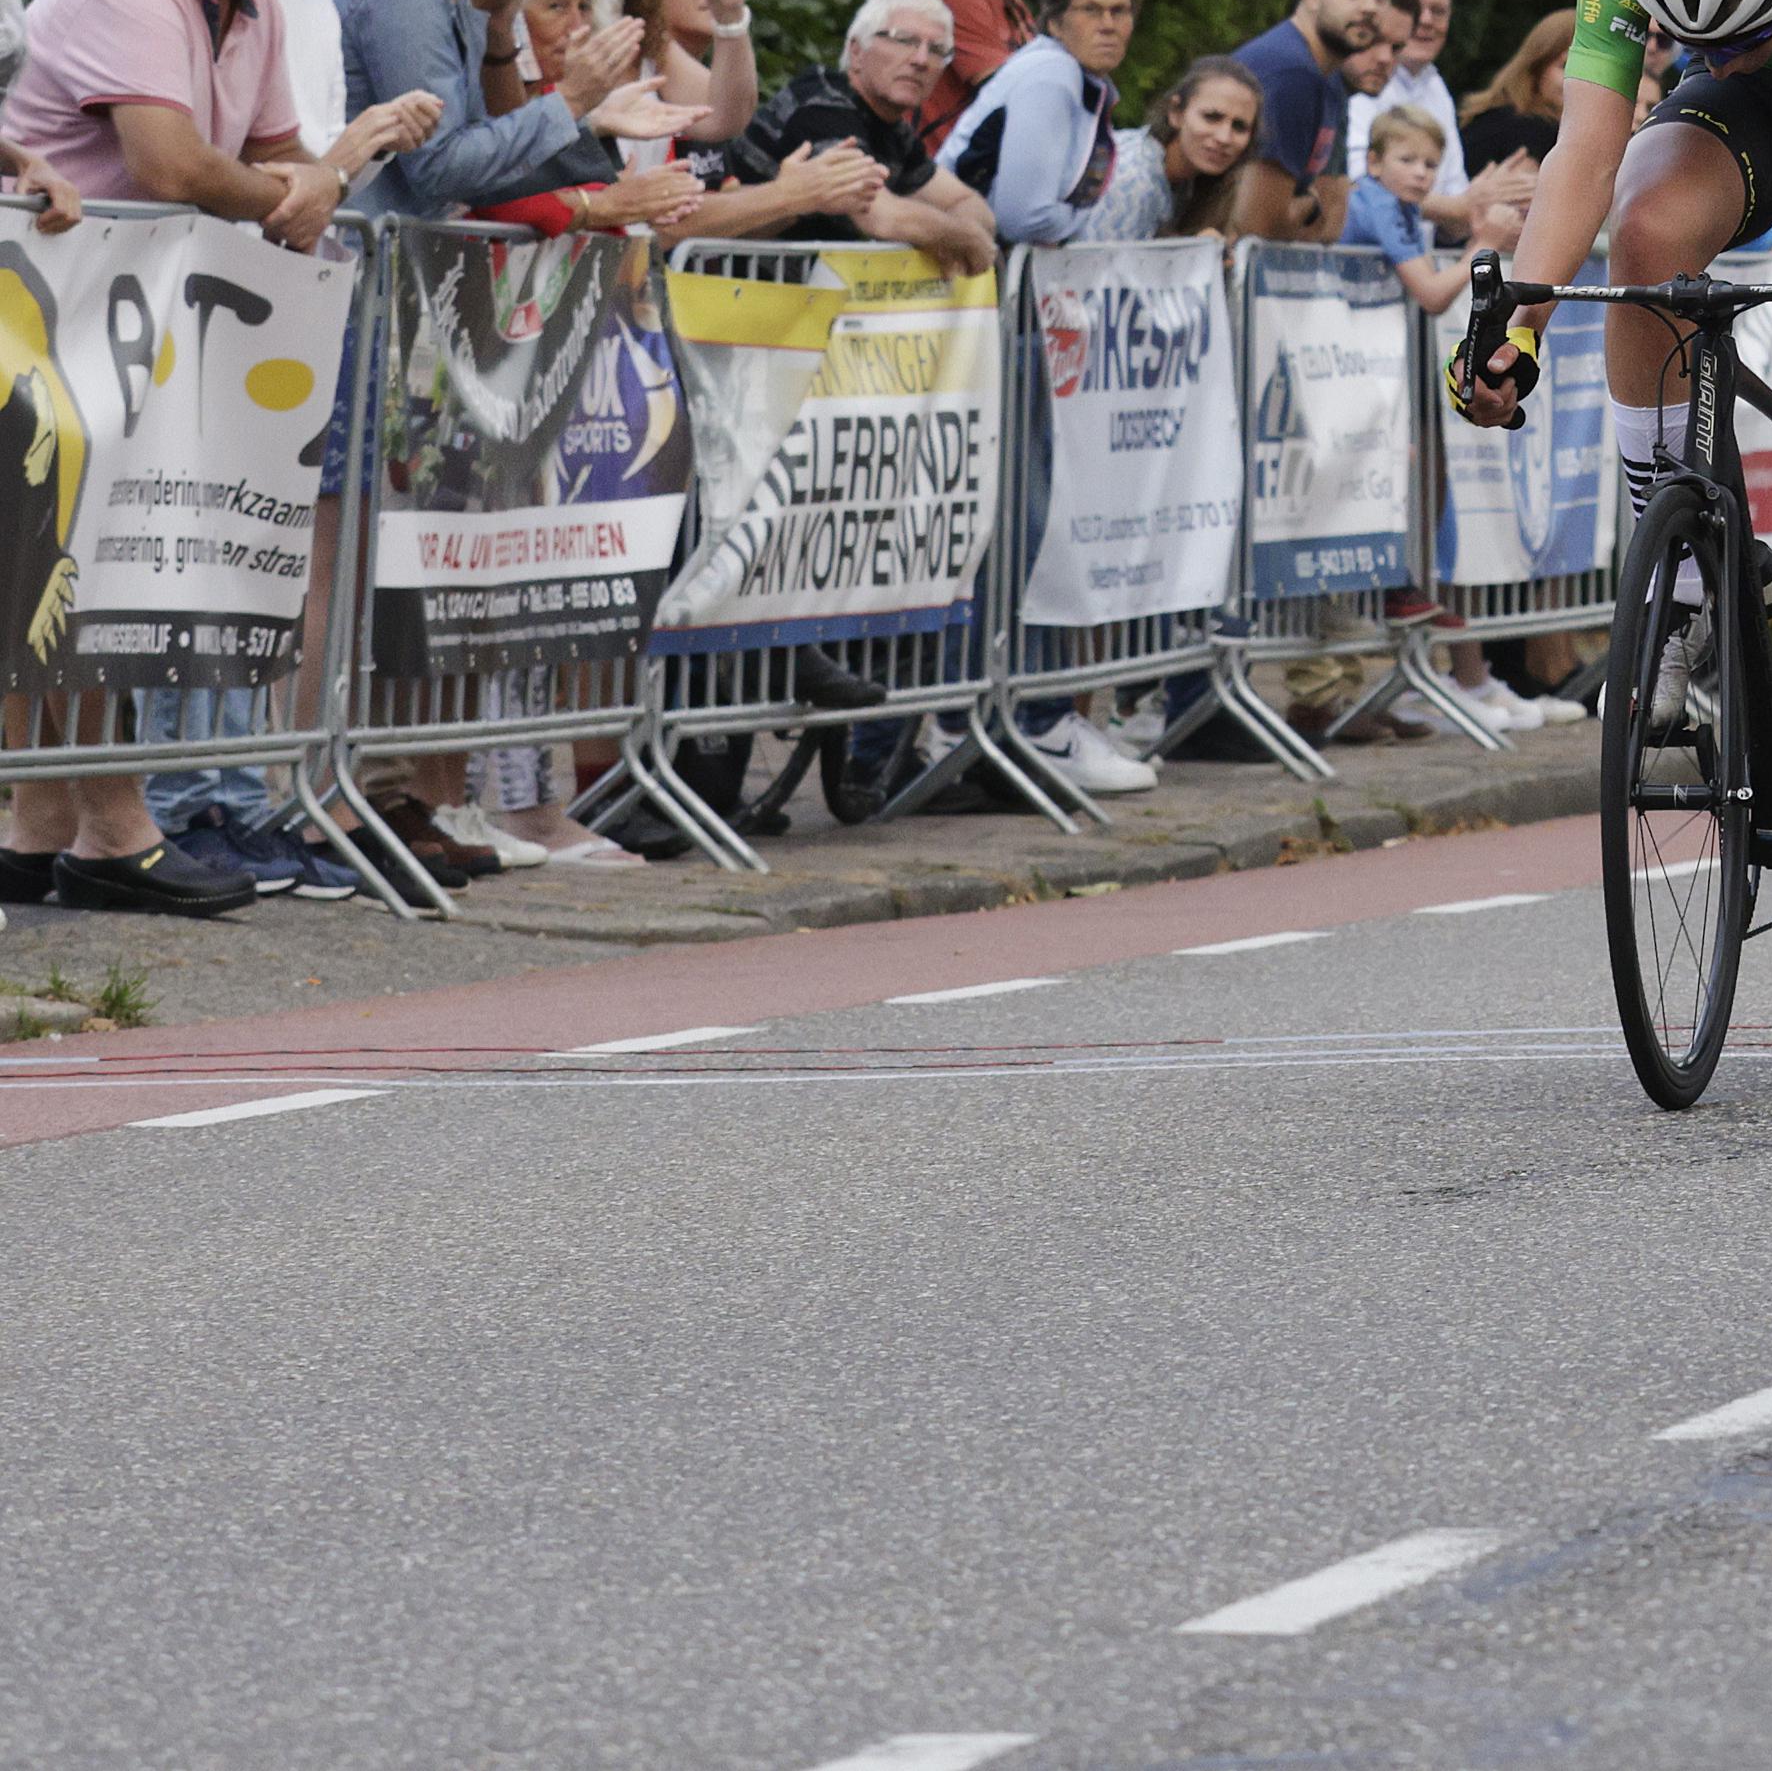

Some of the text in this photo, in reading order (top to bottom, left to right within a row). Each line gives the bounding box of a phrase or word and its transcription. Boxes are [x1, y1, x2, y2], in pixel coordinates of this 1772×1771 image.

[1680, 108, 1729, 135] FILA
[1695, 347, 1719, 466] GIANT
[611, 577, 637, 605] 83
